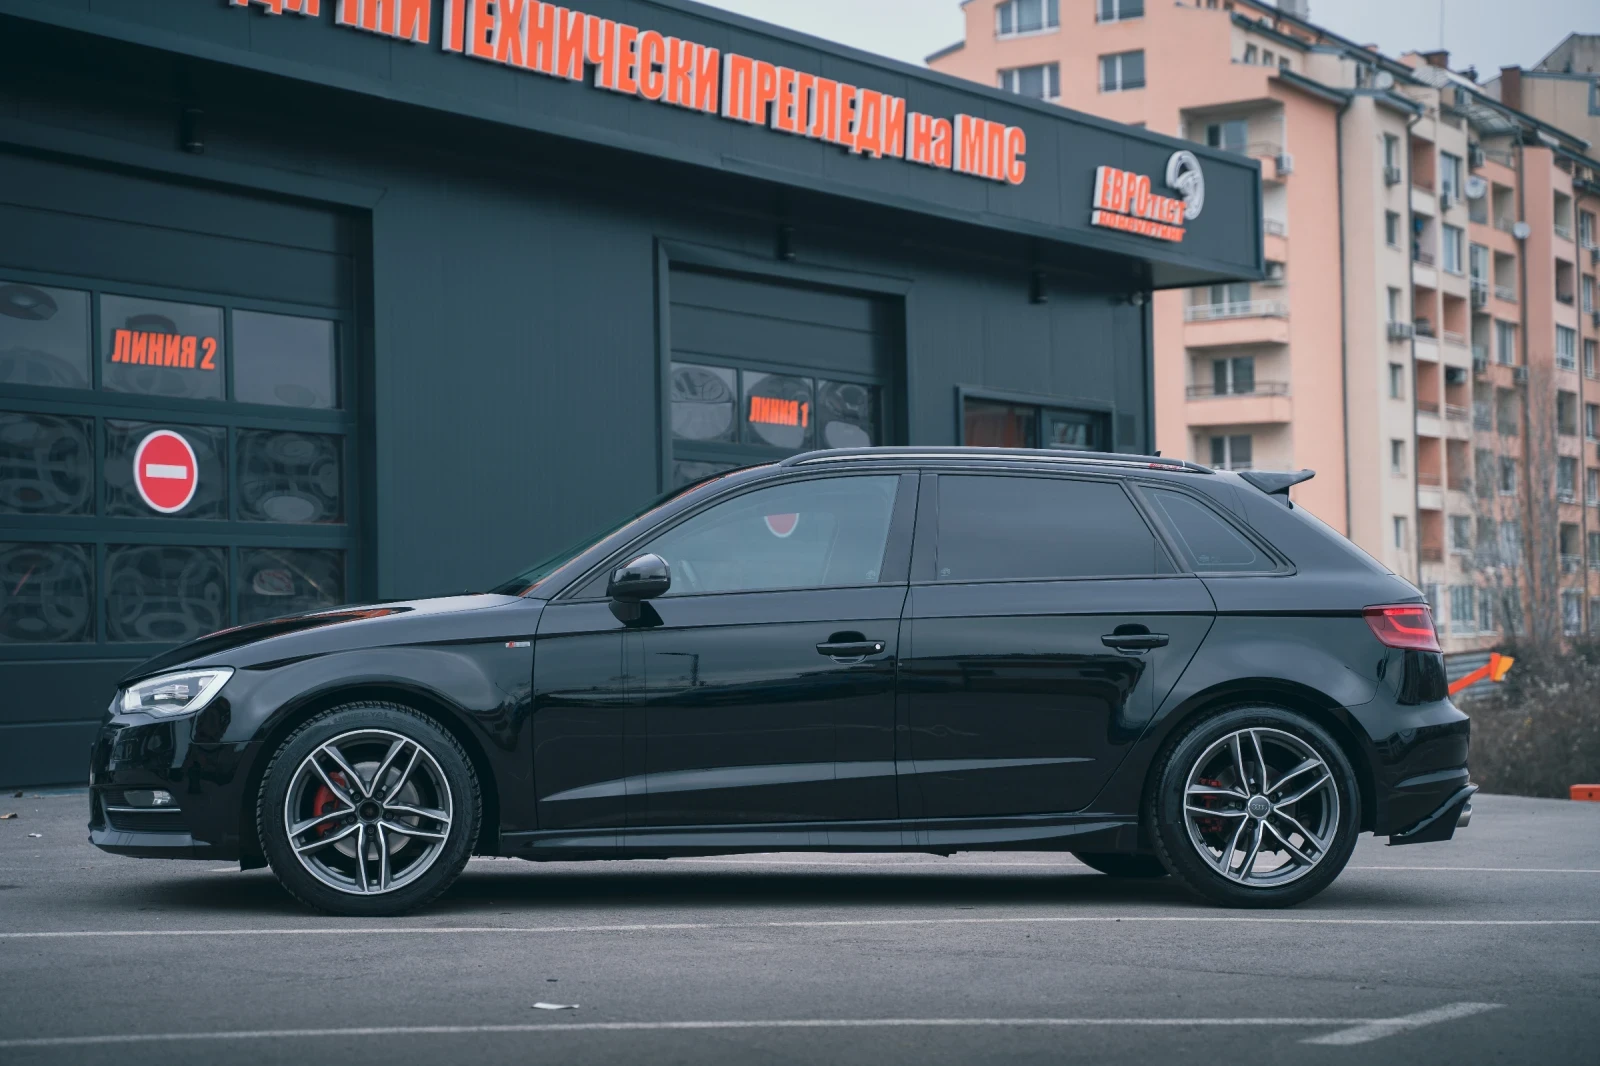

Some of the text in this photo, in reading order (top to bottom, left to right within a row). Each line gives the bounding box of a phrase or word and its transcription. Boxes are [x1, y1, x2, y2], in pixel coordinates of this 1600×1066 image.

[725, 53, 906, 158] ПРЕГЛЕДИ
[909, 112, 953, 168] на
[956, 113, 1026, 185] МПС
[112, 329, 217, 371] ЛИНИЯ 2
[749, 395, 809, 428] ЛИНИЯ 1
